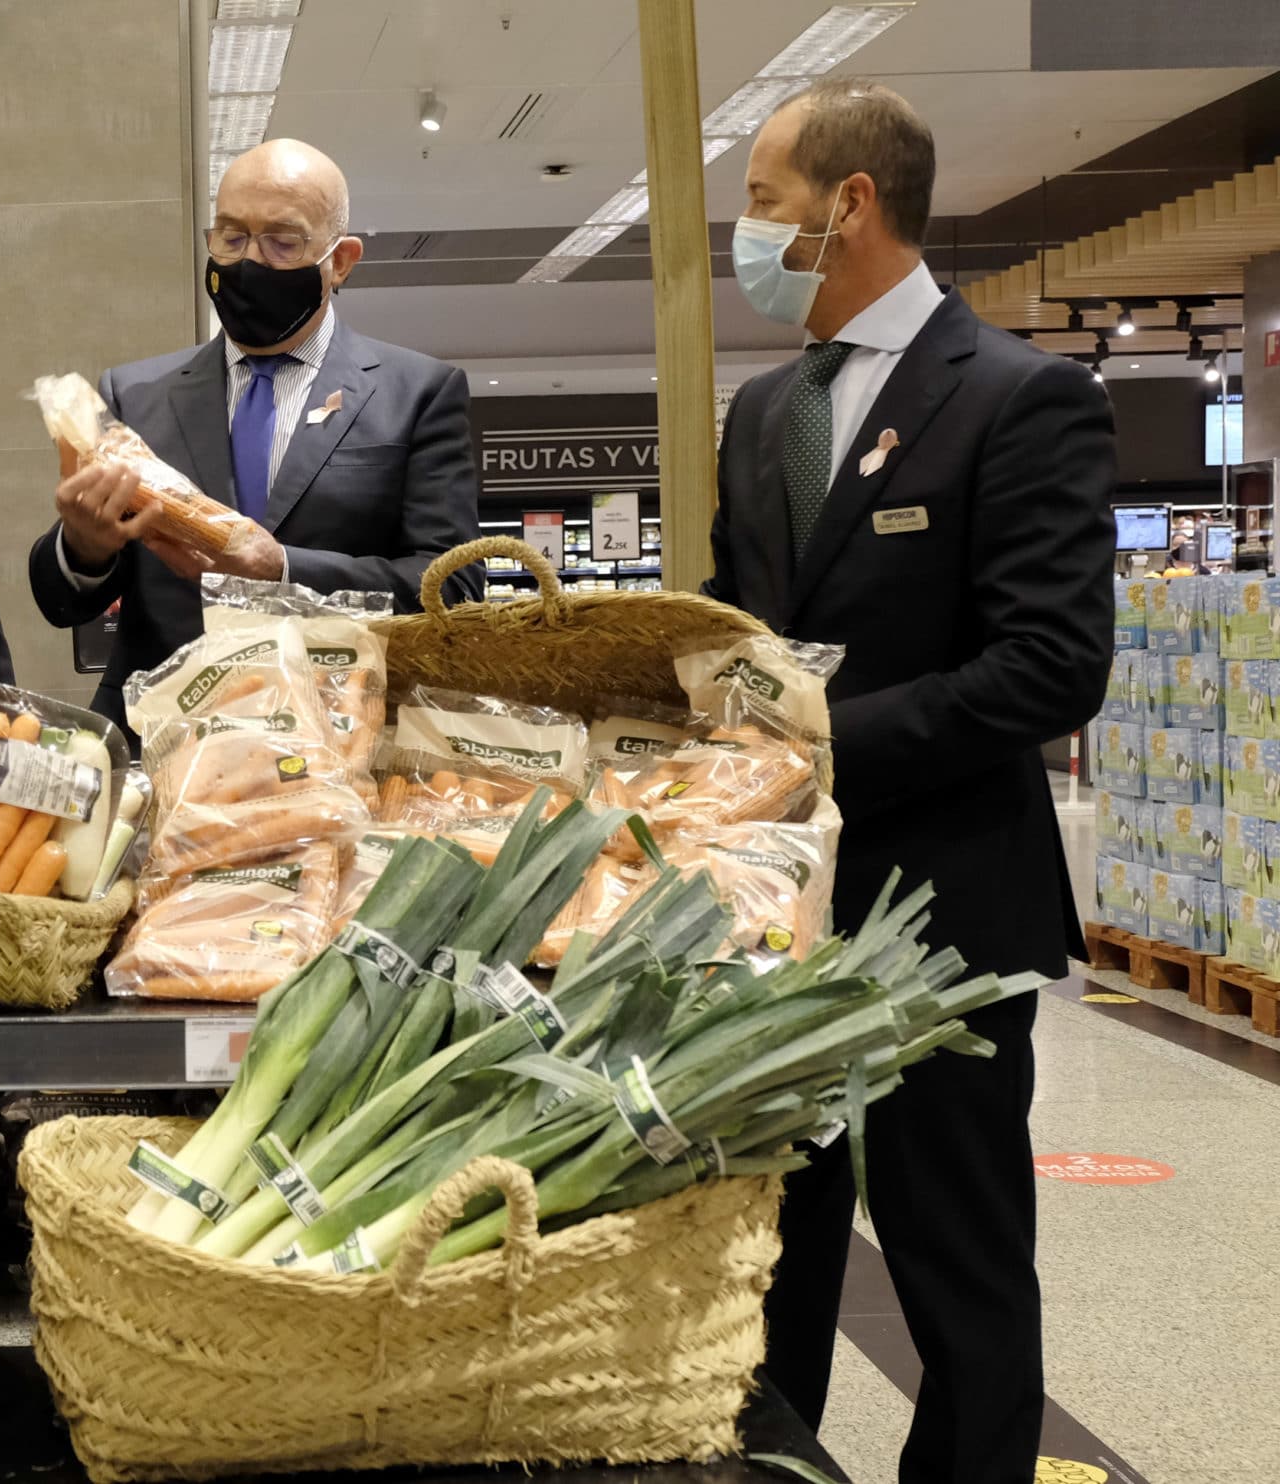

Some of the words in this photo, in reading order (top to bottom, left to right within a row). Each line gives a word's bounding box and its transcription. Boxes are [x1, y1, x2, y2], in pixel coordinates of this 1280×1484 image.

[482, 447, 595, 471] FRUTAS
[604, 446, 623, 467] Y
[182, 641, 272, 708] tabuenca
[1034, 1163, 1153, 1172] Metros
[1066, 1156, 1098, 1165] 2
